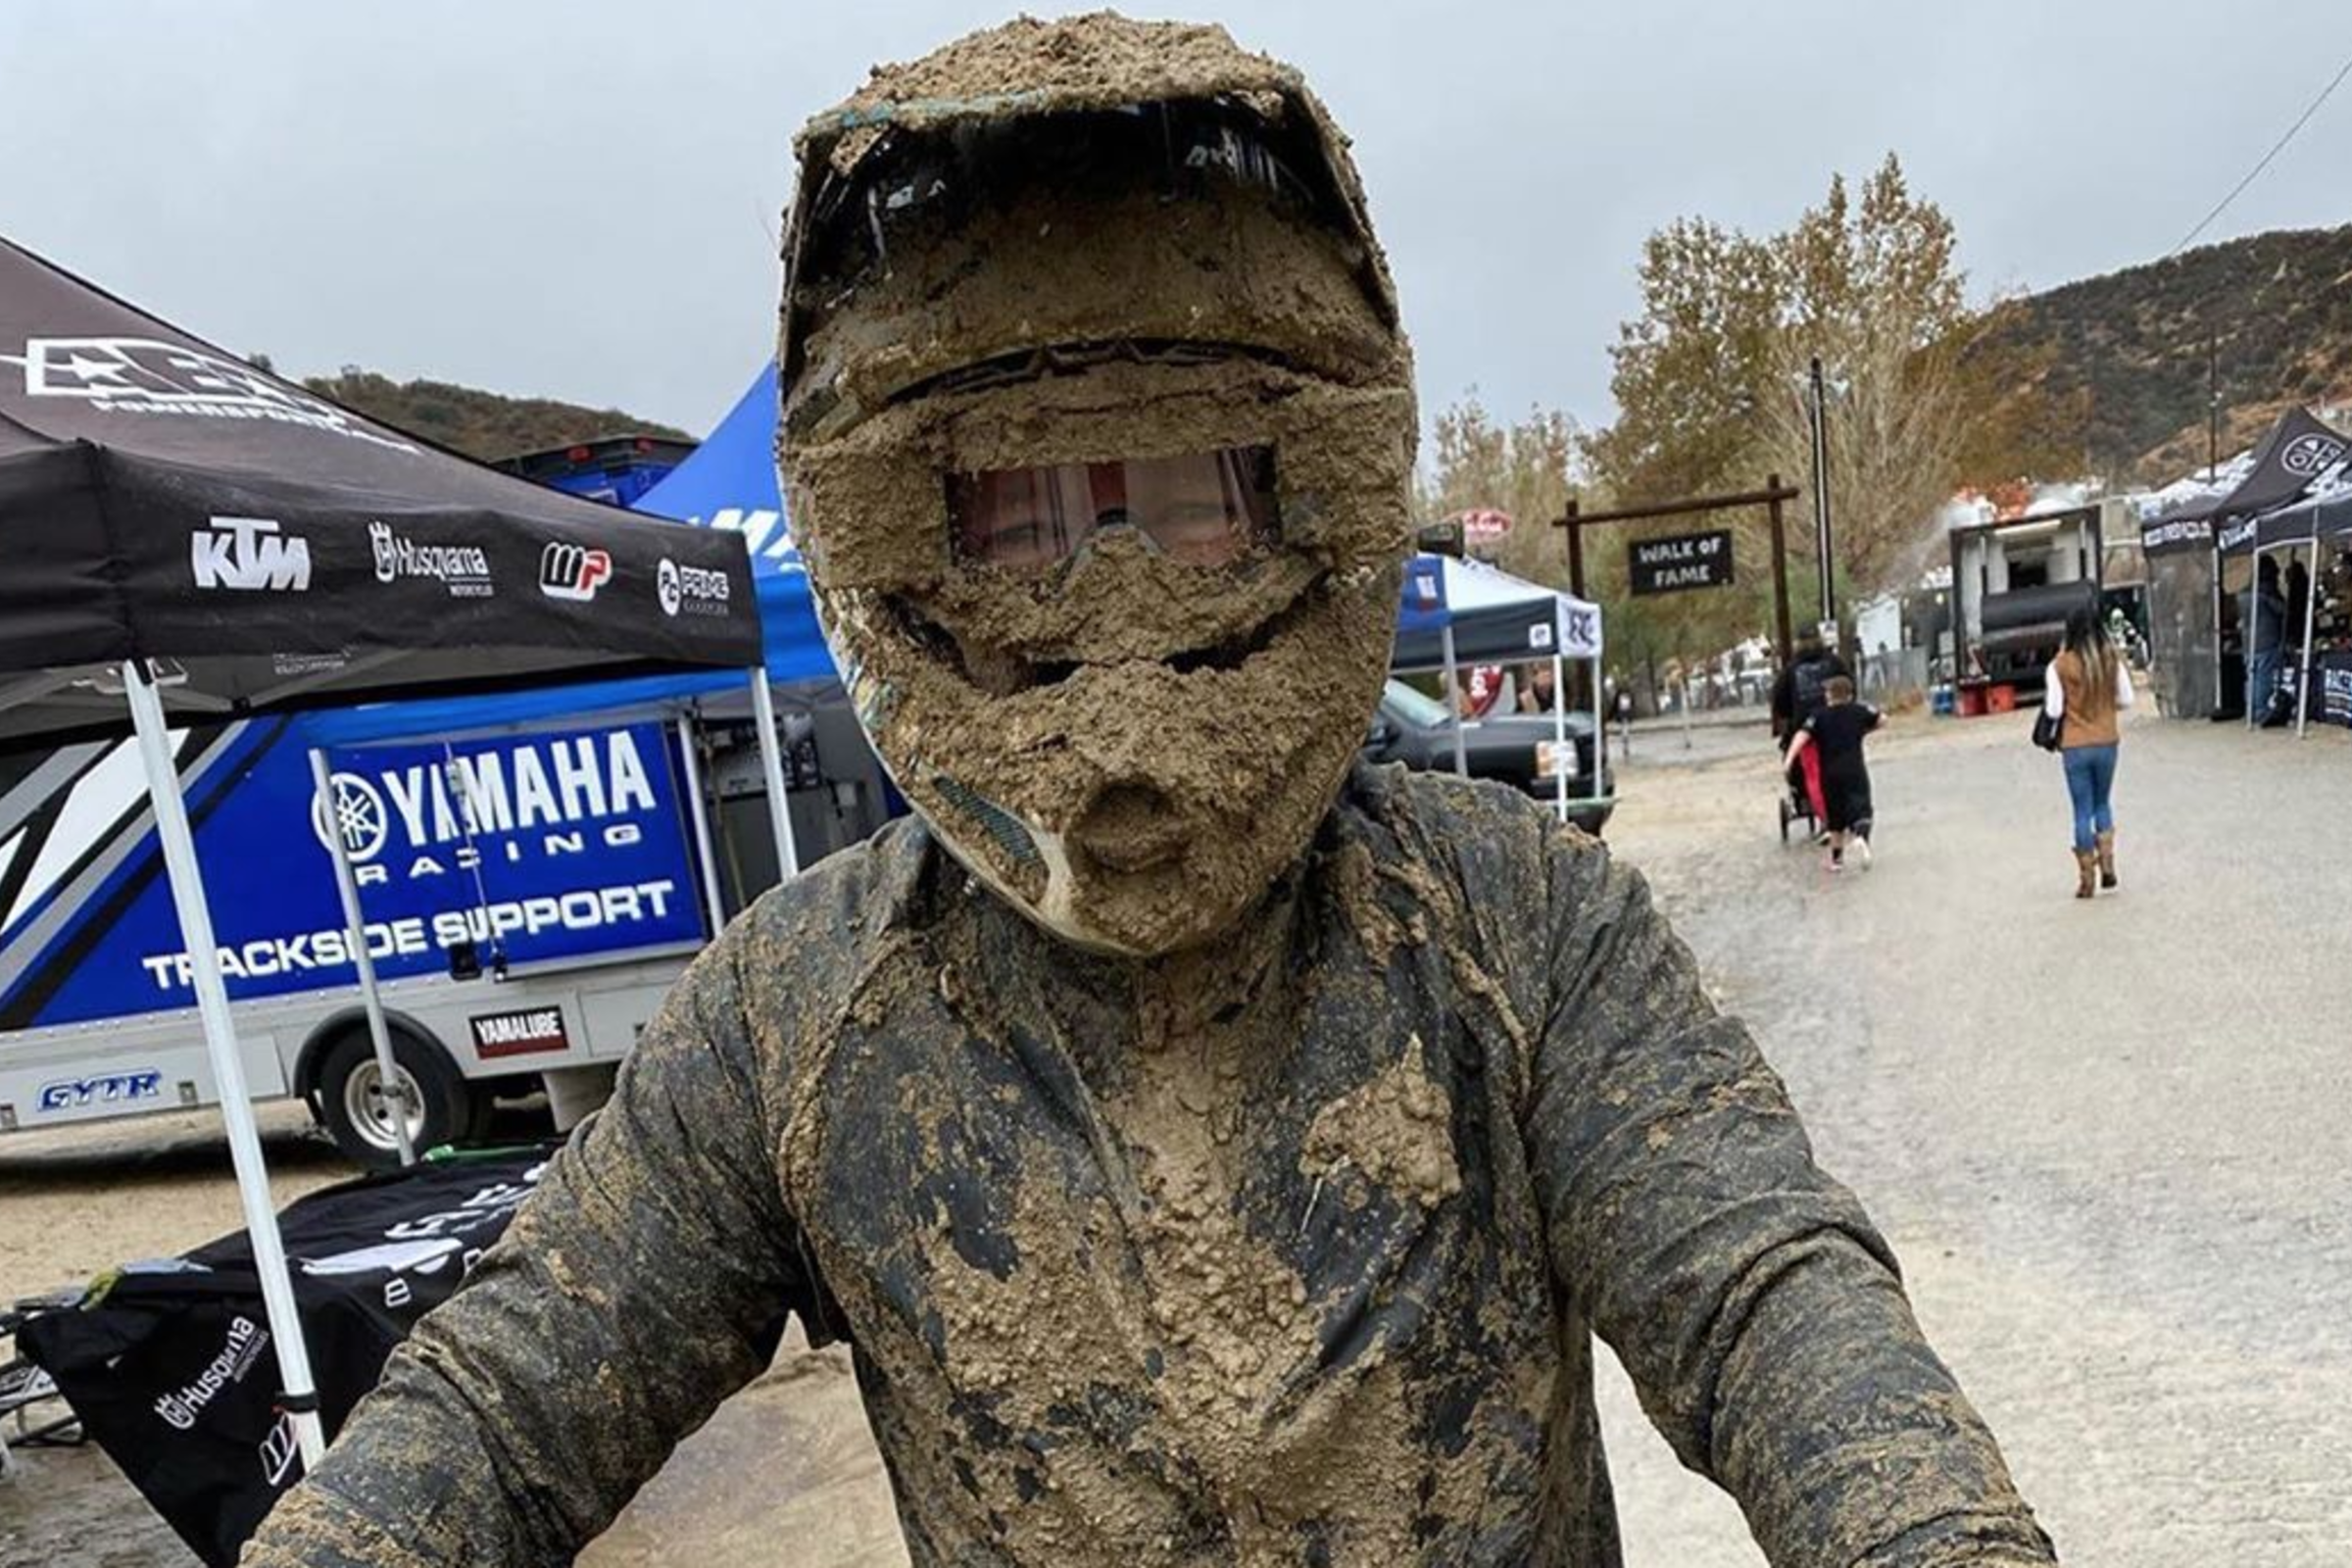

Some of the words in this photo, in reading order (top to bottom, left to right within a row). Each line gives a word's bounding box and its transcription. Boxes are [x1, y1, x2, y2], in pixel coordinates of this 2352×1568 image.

[192, 516, 311, 590] KTM
[394, 538, 489, 580] Husqvarna
[1639, 539, 1693, 564] WALK
[1698, 536, 1722, 555] OF
[1654, 564, 1710, 587] FAME
[381, 730, 657, 847] YAMAHA
[433, 879, 674, 948] SUPPORT
[474, 1011, 562, 1046] YAMALUBE
[38, 1068, 162, 1111] GYTR
